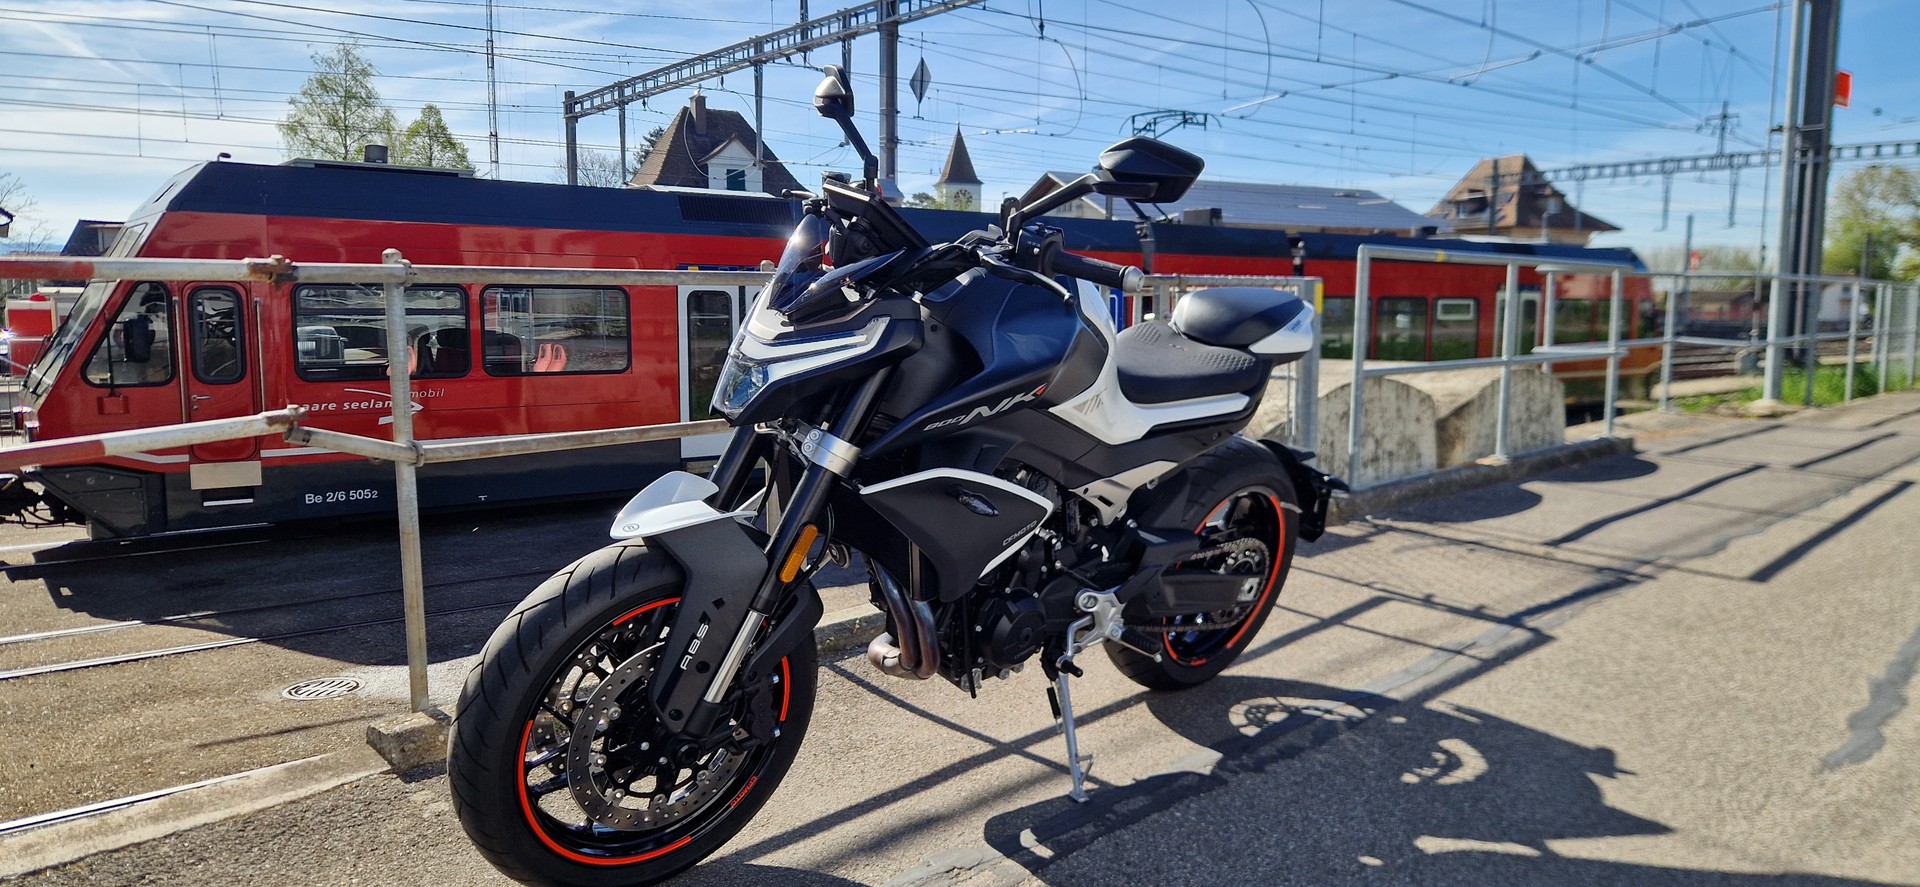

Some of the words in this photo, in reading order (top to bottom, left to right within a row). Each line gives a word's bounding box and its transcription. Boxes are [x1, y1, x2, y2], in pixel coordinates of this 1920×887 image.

[410, 388, 445, 398] mobil
[343, 399, 393, 410] seelan
[305, 493, 323, 504] Be
[326, 491, 346, 503] 2/6
[1002, 520, 1037, 546] CFMOTO
[680, 623, 709, 670] ABS
